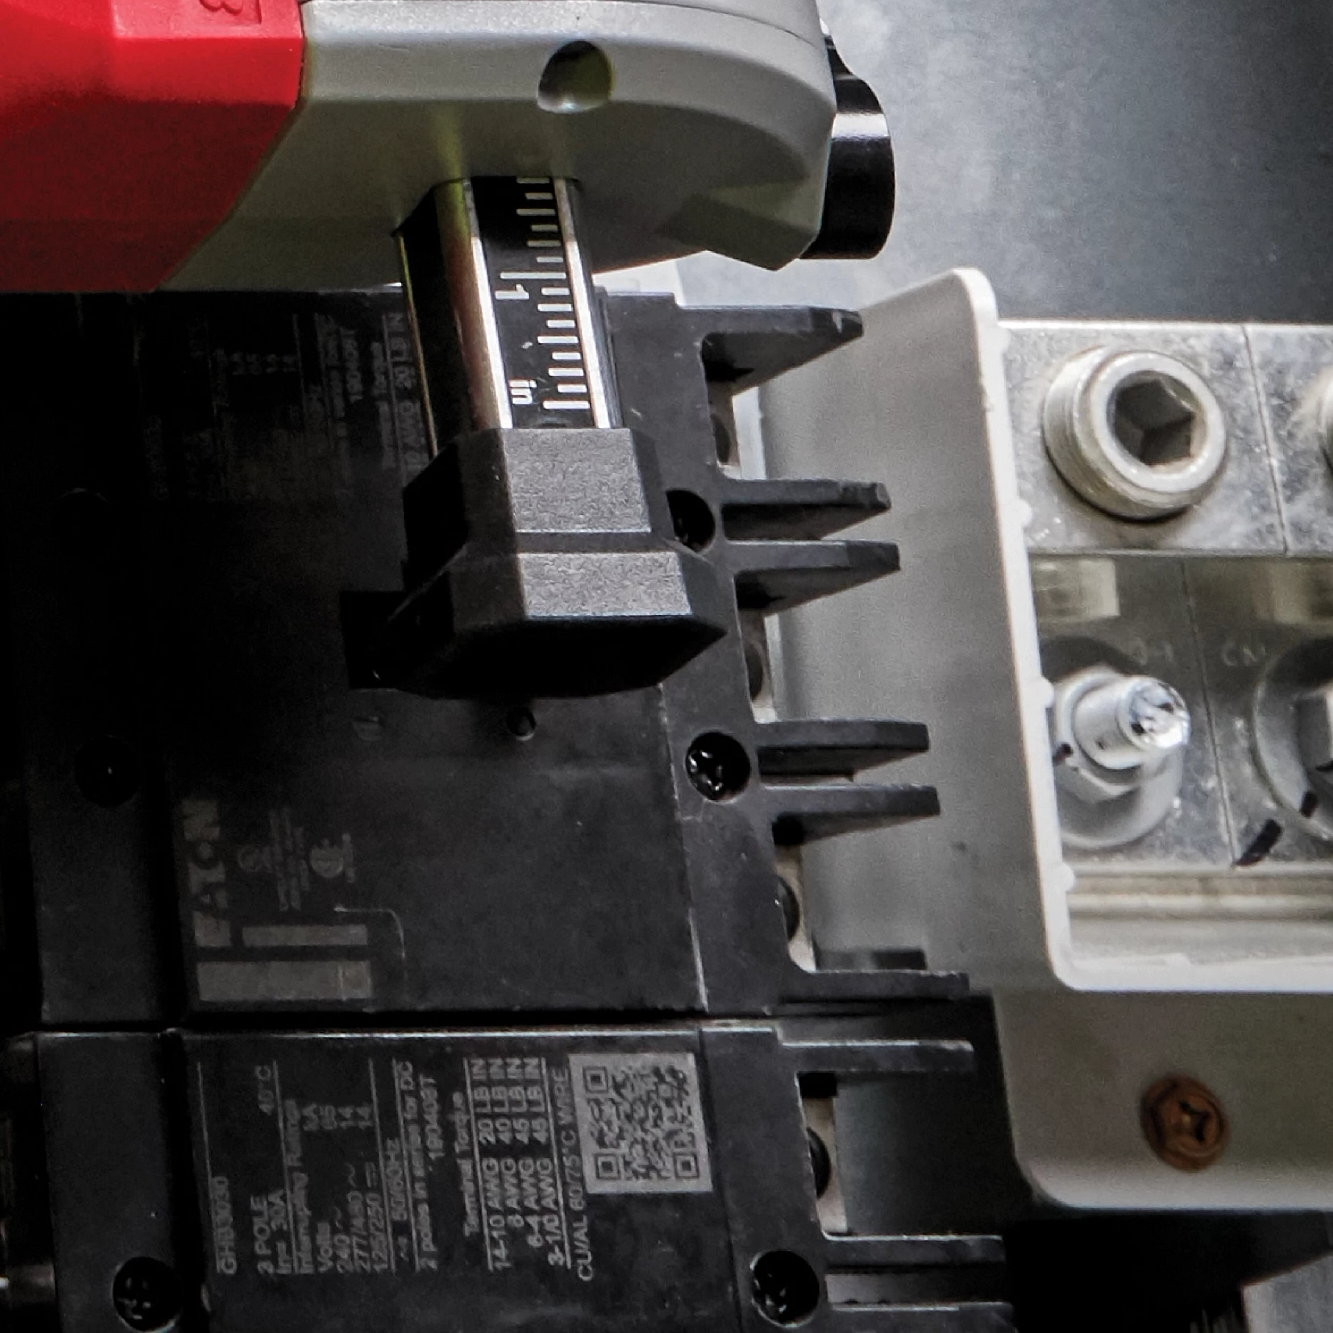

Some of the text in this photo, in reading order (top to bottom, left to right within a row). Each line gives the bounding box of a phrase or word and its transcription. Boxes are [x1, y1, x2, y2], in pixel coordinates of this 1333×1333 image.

[510, 379, 537, 404] in
[397, 1061, 415, 1090] DC
[403, 1095, 418, 1119] for
[553, 1067, 572, 1125] WIRE
[337, 1106, 356, 1129] 14
[487, 1058, 524, 1227] 8 AWG 40 LB IN
[449, 1092, 481, 1237] Terminal Torque
[471, 1058, 511, 1270] 14-10 AWG 20 LB IN
[505, 1058, 543, 1248] 6-4 AWG 45 LB IN
[524, 1058, 566, 1266] 3-1/0 AWG 45 LB IN
[356, 1105, 388, 1272] 125/250 14
[251, 1195, 272, 1255] POLE
[417, 1203, 438, 1252] poles
[572, 1215, 594, 1281] CU/AL
